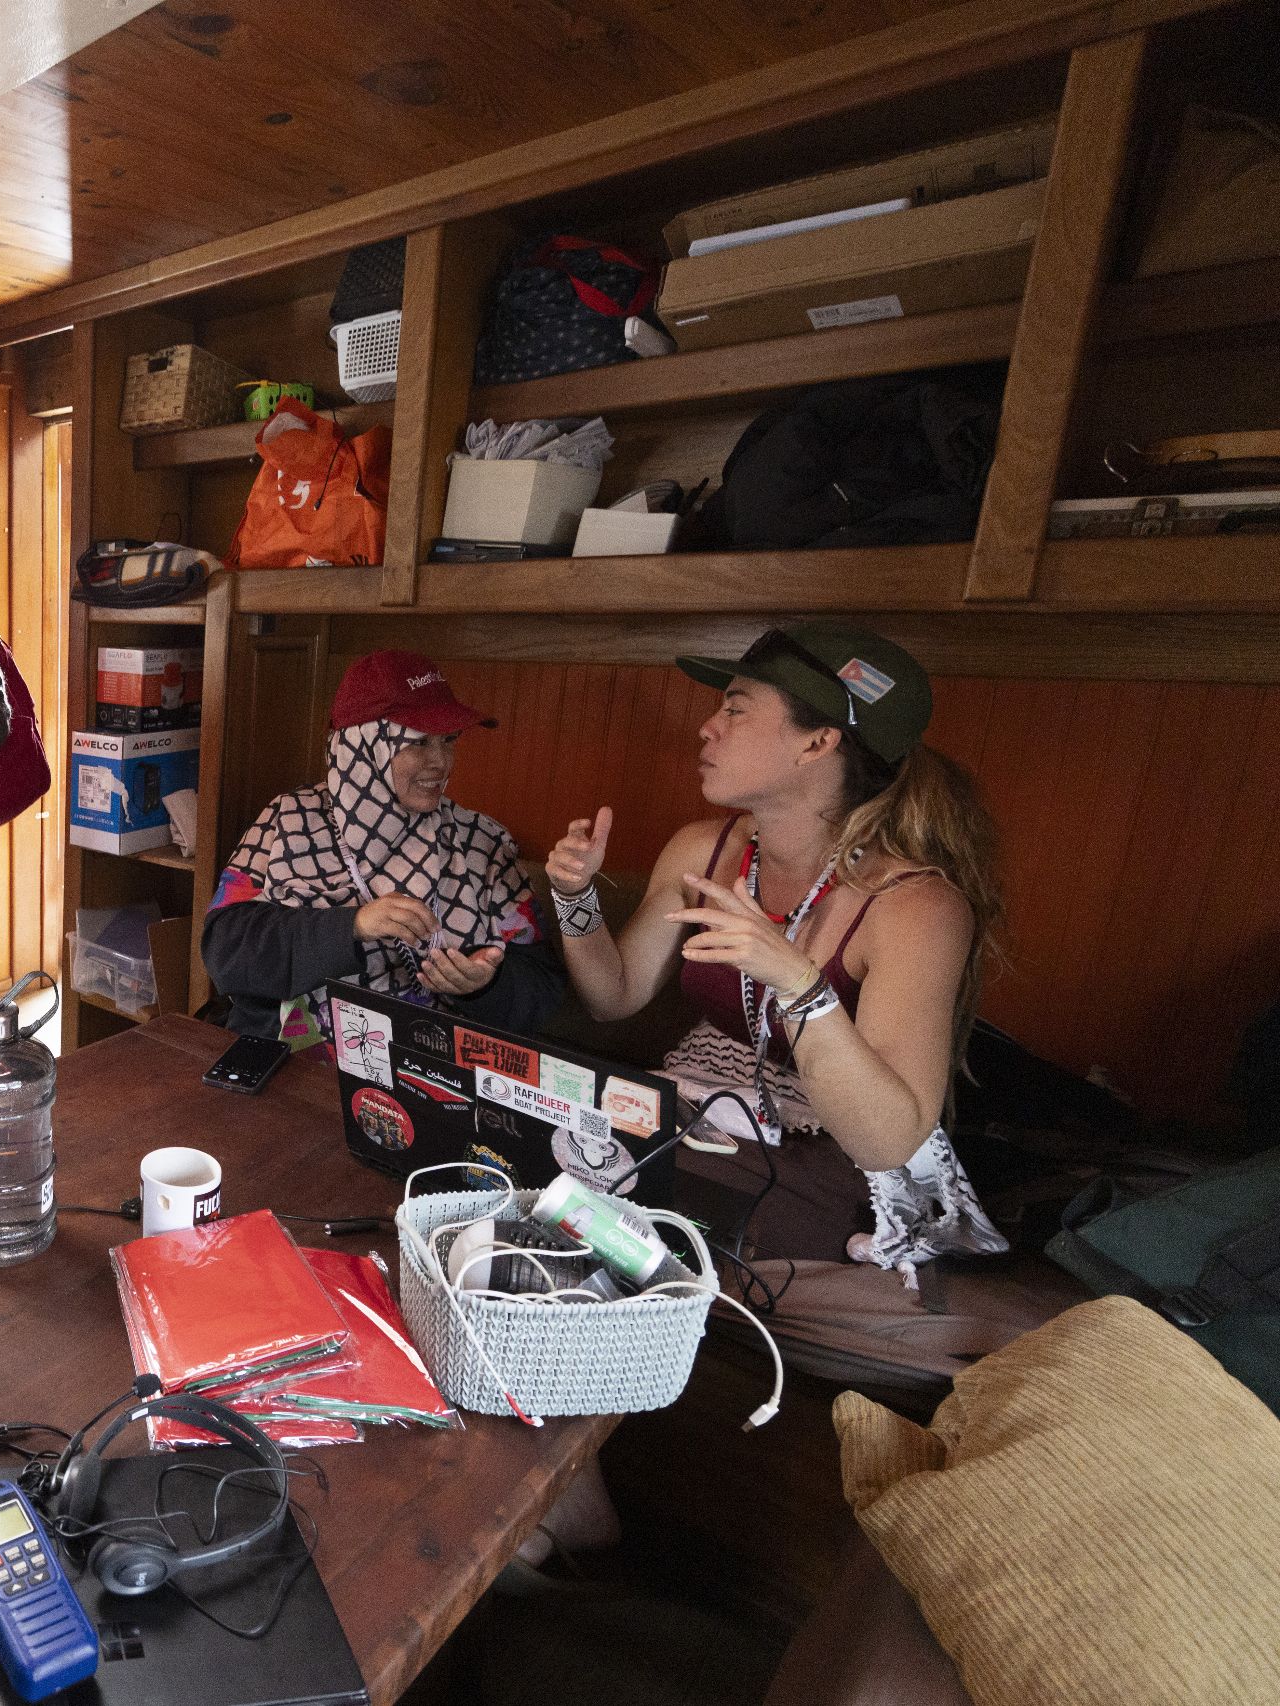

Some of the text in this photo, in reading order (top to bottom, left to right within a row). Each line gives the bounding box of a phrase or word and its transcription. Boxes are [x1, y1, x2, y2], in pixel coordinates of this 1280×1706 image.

[74, 738, 119, 752] AWELCO
[132, 738, 172, 751] AWELCO
[403, 1058, 422, 1071] حرة
[426, 1069, 462, 1089] فلسطين
[514, 1085, 571, 1115] RAFIQUEER
[514, 1097, 532, 1112] BOAT
[534, 1106, 571, 1125] PROJECT
[567, 1162, 616, 1185] MIKO LOK
